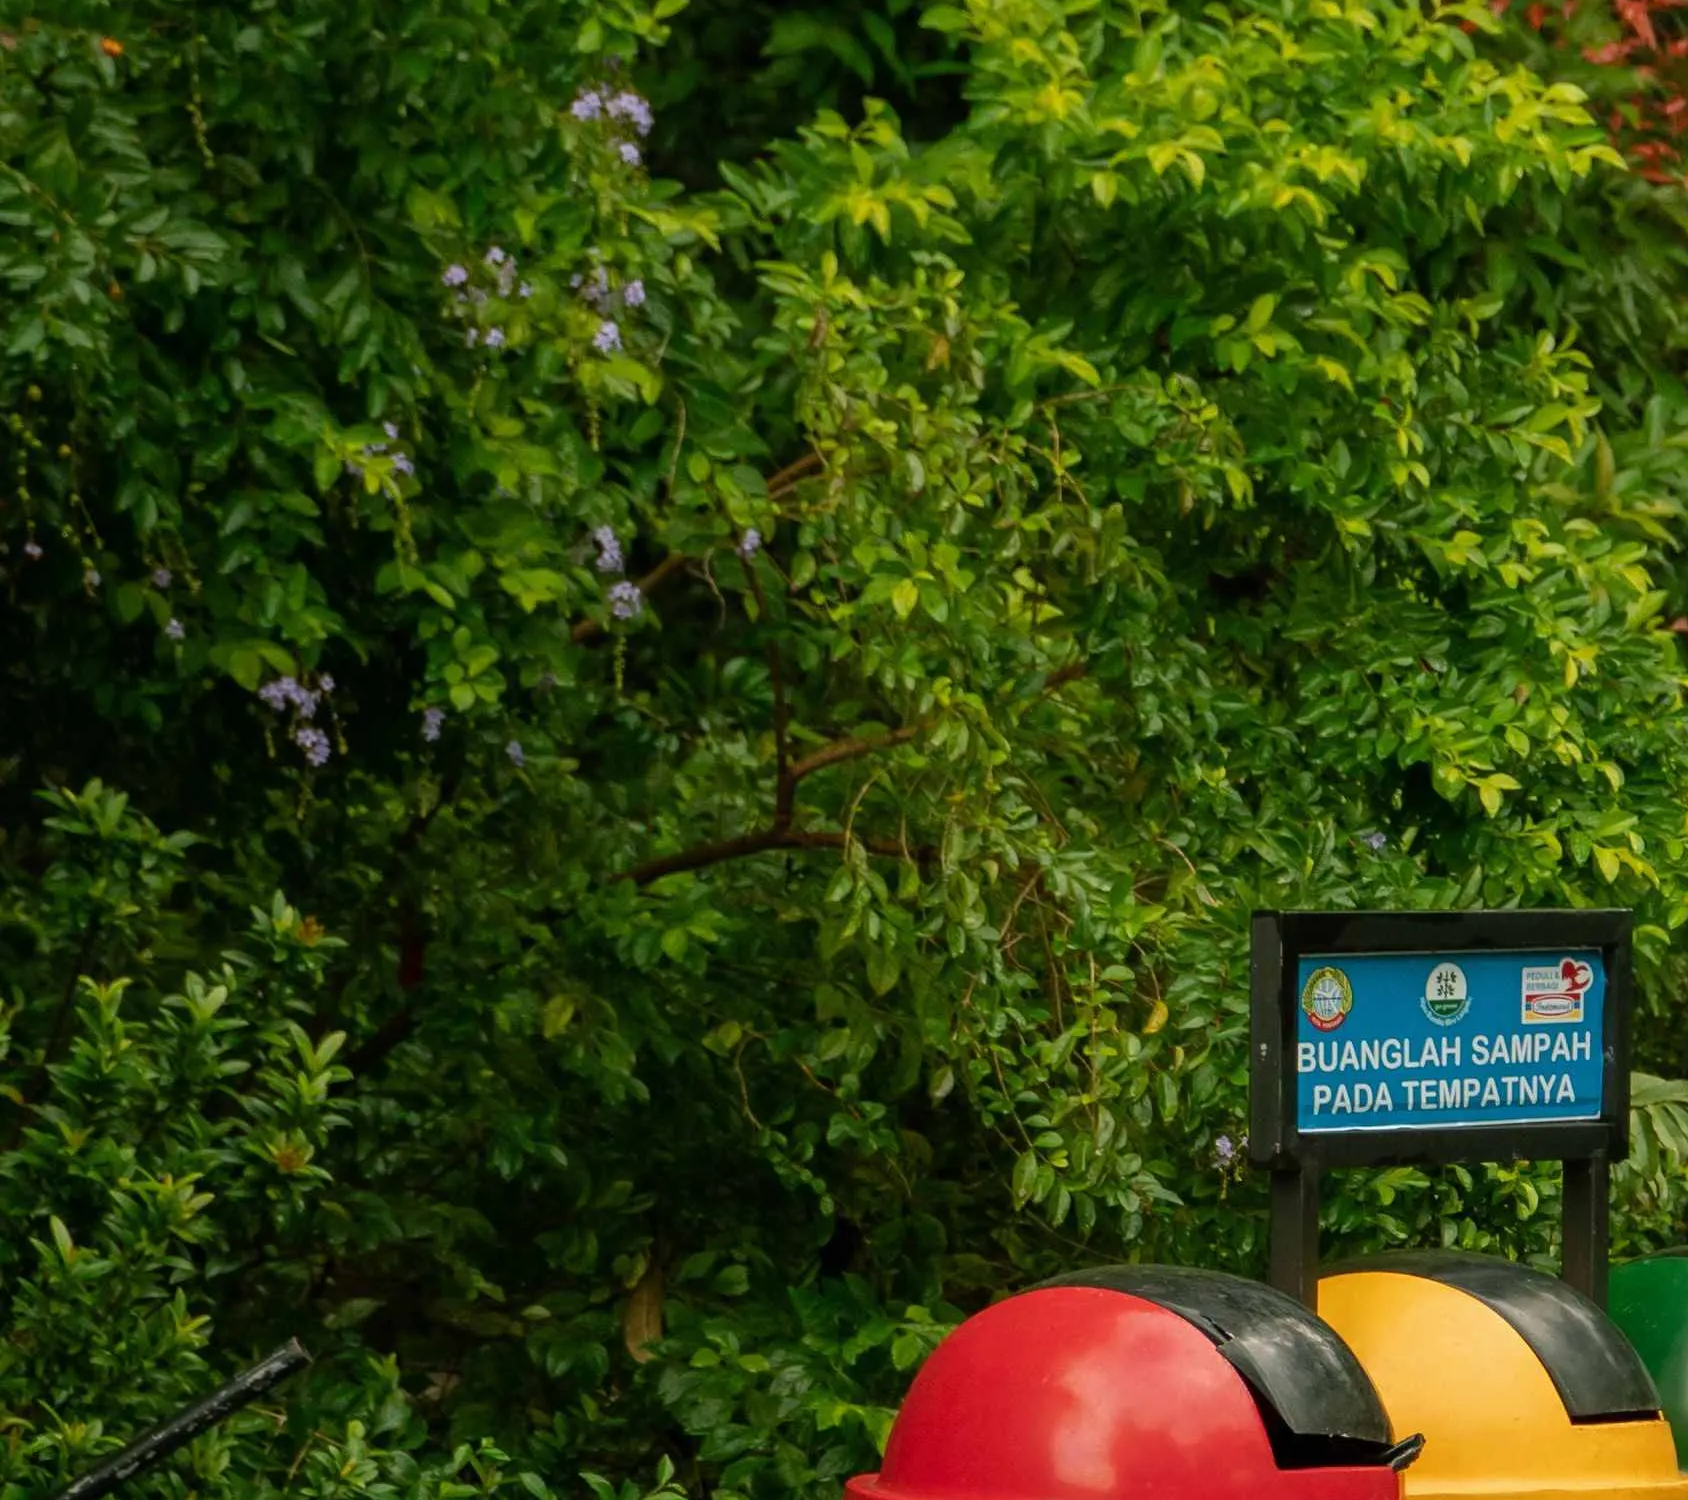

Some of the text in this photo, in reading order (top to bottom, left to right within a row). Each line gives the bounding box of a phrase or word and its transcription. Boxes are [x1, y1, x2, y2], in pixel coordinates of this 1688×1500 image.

[1297, 1031, 1591, 1073] BUANGLAH SAMPAH
[1313, 1073, 1576, 1116] PADA TEMPATNYA
